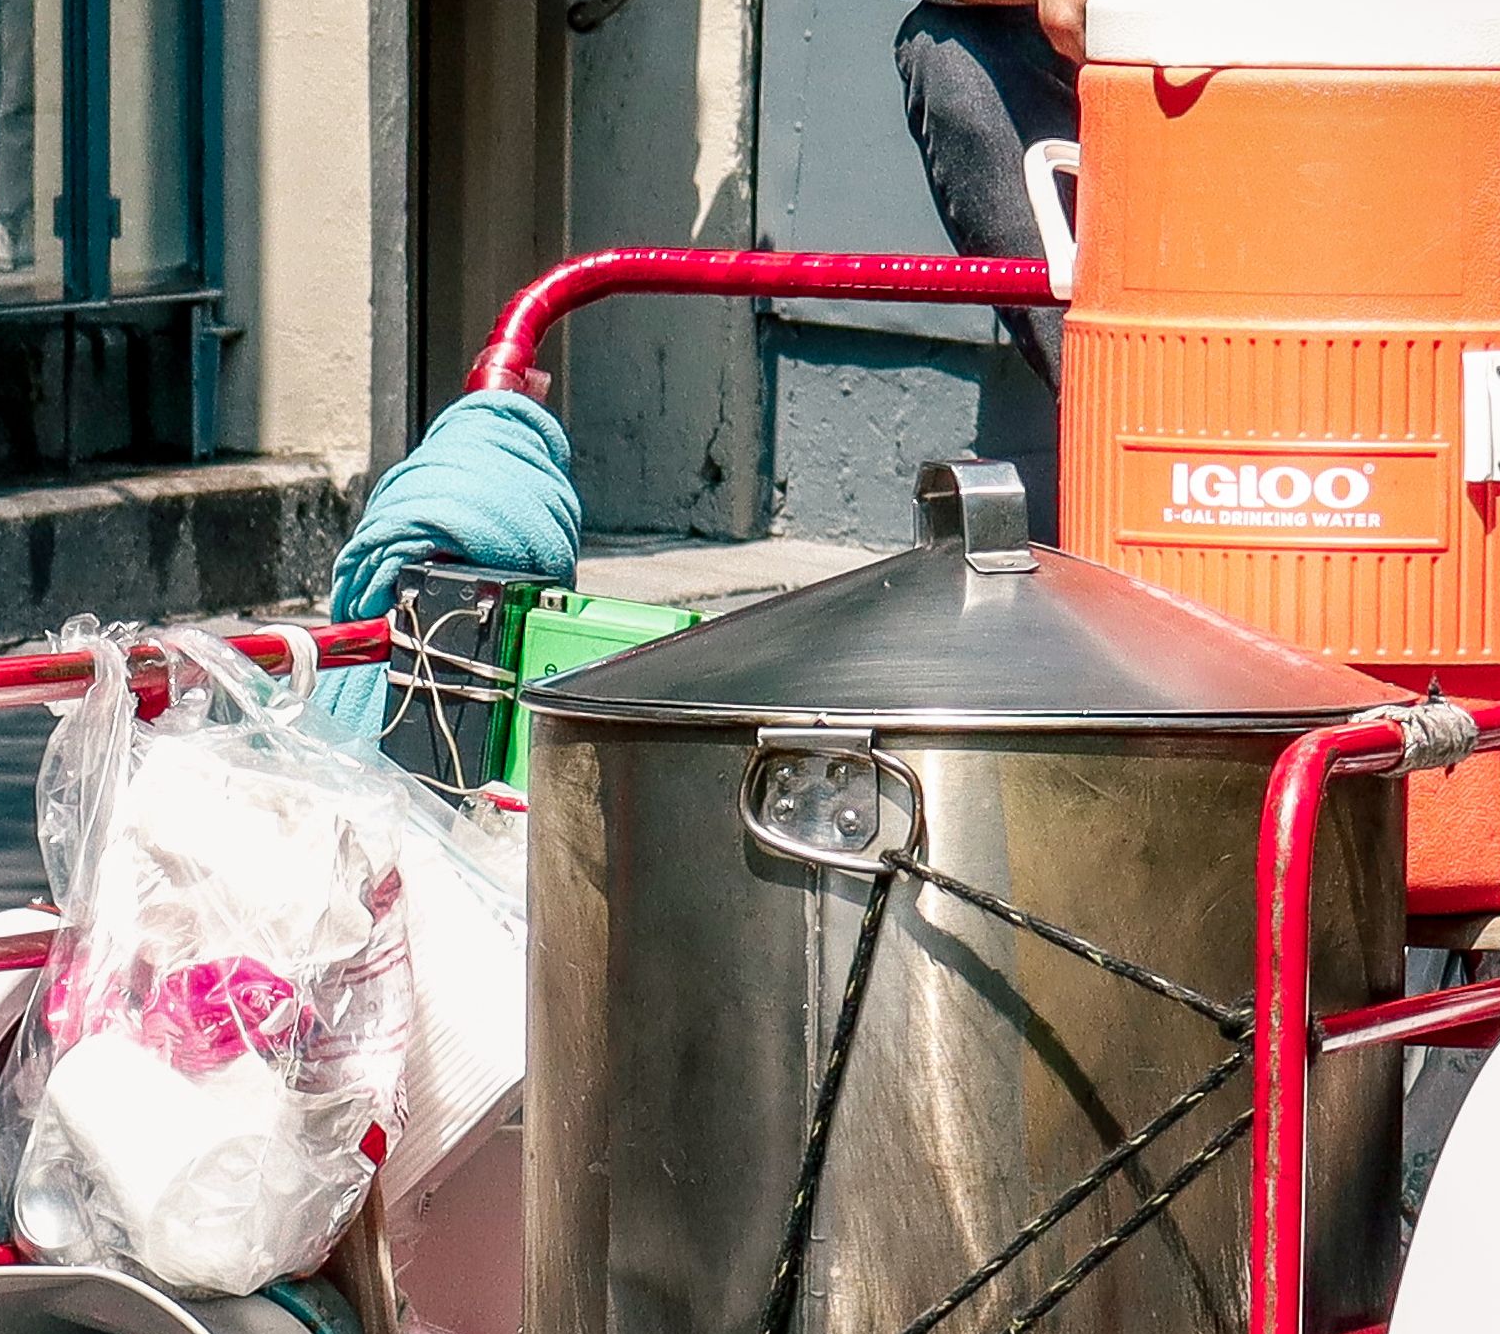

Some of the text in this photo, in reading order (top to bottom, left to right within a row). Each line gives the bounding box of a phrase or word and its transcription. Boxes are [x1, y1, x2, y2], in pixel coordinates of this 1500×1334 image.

[1172, 463, 1370, 509] IGLOO
[1163, 508, 1382, 528] 5-GAL DRINKING WATER
